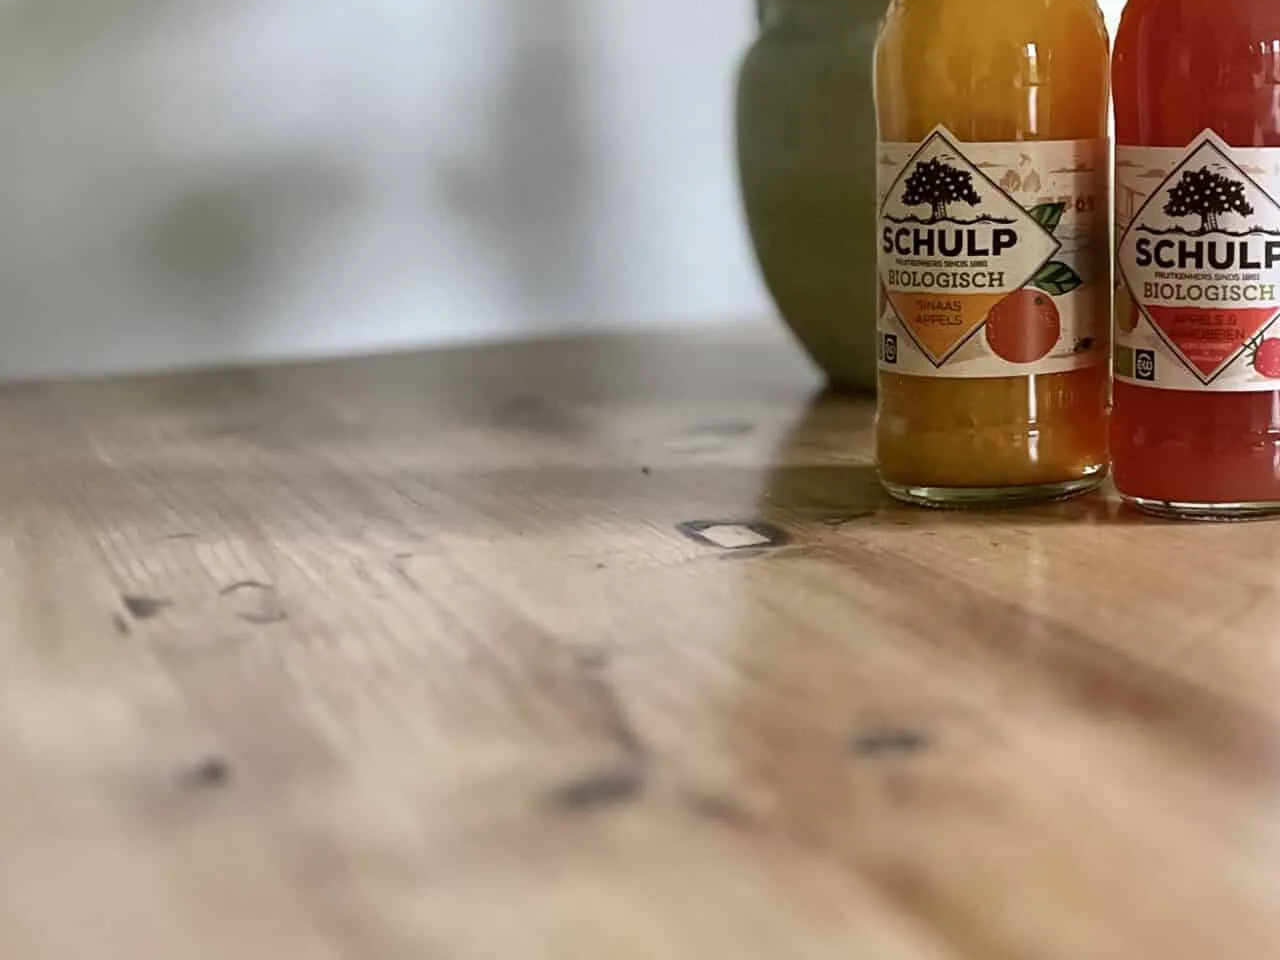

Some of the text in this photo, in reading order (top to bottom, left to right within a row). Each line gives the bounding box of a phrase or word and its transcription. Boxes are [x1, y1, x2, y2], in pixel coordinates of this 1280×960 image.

[883, 227, 1018, 257] SCHULP
[888, 269, 1006, 289] BIOLOGISCH
[1143, 282, 1276, 302] BIOLOGISCH
[915, 299, 963, 313] SINAAS
[914, 314, 963, 326] APPELS
